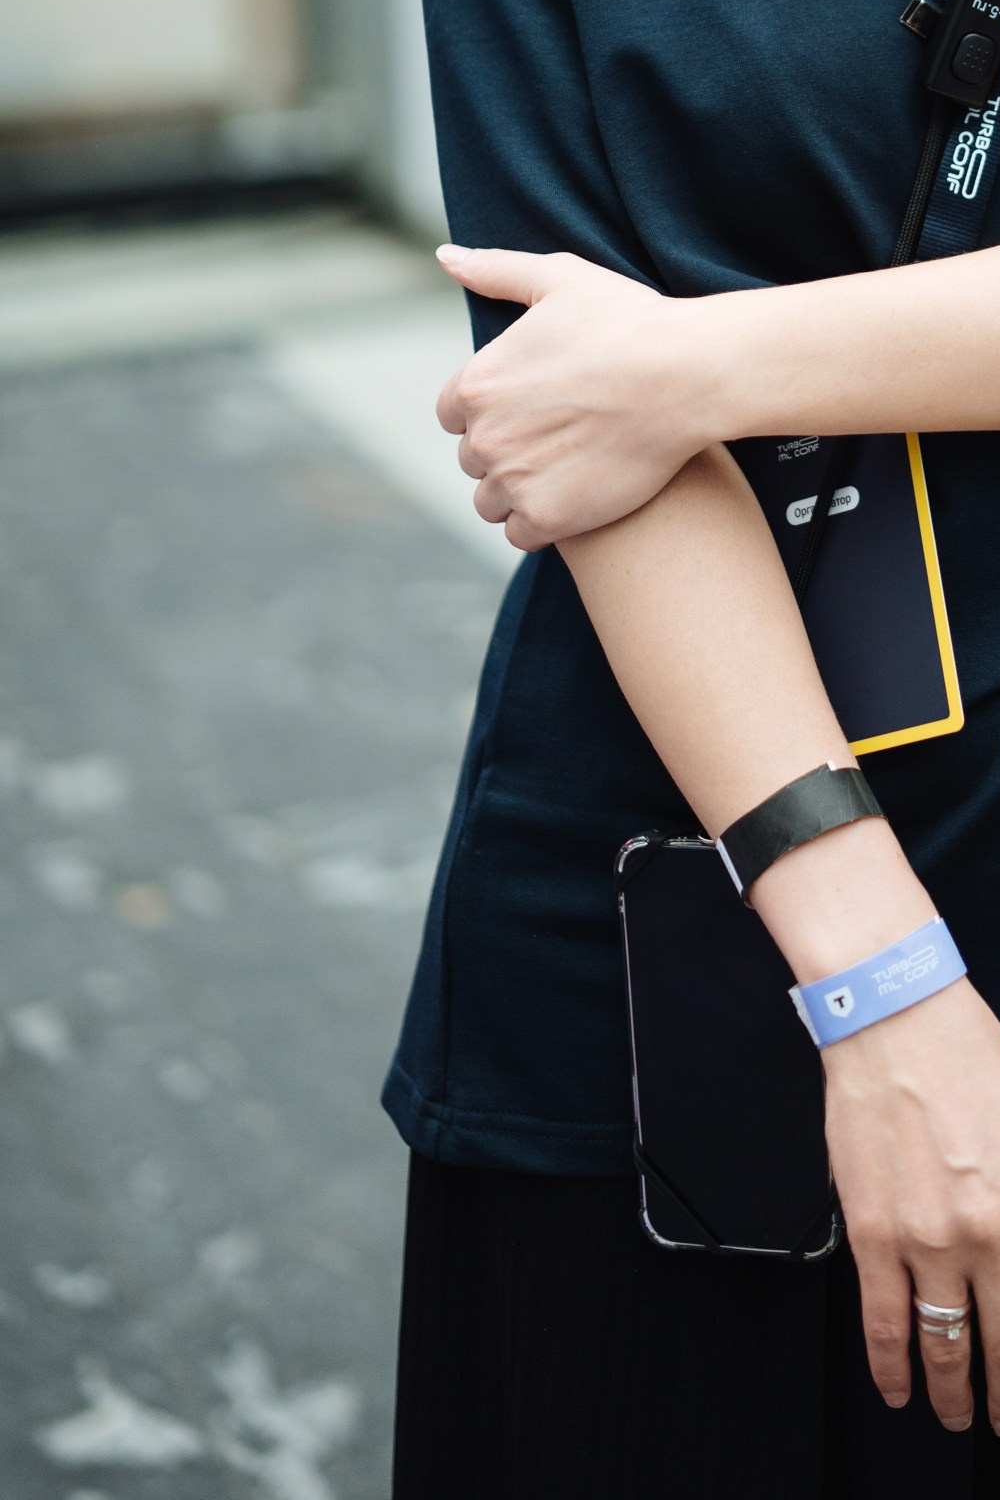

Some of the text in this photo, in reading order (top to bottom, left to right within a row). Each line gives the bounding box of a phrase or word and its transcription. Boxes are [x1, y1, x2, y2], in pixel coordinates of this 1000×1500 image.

[961, 96, 1000, 199] TURBO
[946, 131, 974, 194] CONF
[777, 435, 819, 453] TURBO
[794, 443, 819, 457] CONF
[871, 944, 936, 984] TURBO
[904, 956, 938, 984] CONF
[833, 995, 845, 1008] T
